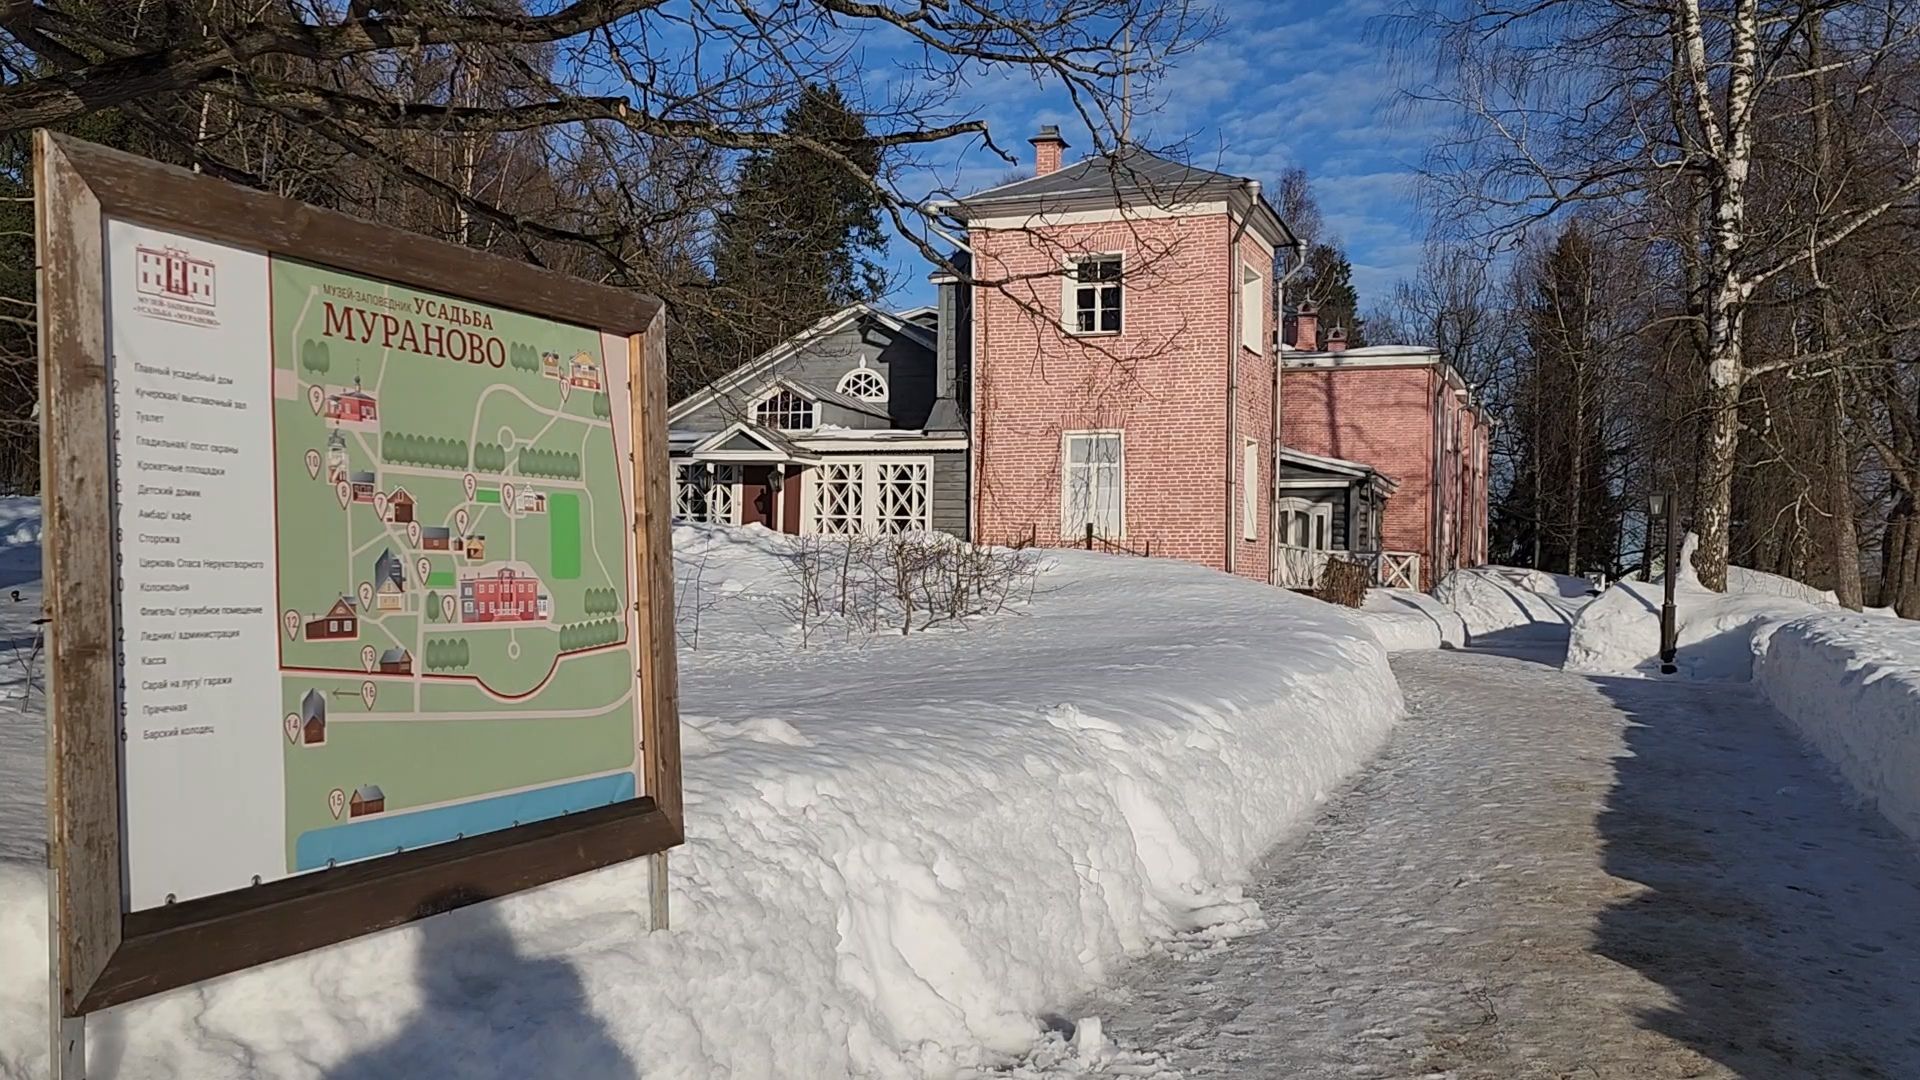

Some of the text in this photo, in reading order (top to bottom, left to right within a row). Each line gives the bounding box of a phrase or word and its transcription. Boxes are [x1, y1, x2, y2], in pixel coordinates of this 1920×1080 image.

[323, 284, 494, 331] МУЗЕЙ-ЗАПОВЕДНИК УСАДЬБА
[323, 301, 506, 369] МУРАНОВО
[136, 412, 164, 423] Туалет
[308, 456, 318, 467] 10
[138, 485, 173, 497] Детский
[172, 511, 192, 521] кафе
[139, 533, 180, 545] Сторожка
[139, 558, 175, 570] Церковь
[177, 559, 201, 569] Спаса
[287, 616, 297, 628] 12
[141, 656, 167, 665] Касса
[363, 651, 374, 662] 13
[142, 680, 167, 692] Сарай
[170, 681, 180, 689] на
[143, 704, 187, 716] Прачечная
[288, 720, 298, 731] 14
[144, 728, 179, 740] Барский
[332, 795, 342, 806] 15
